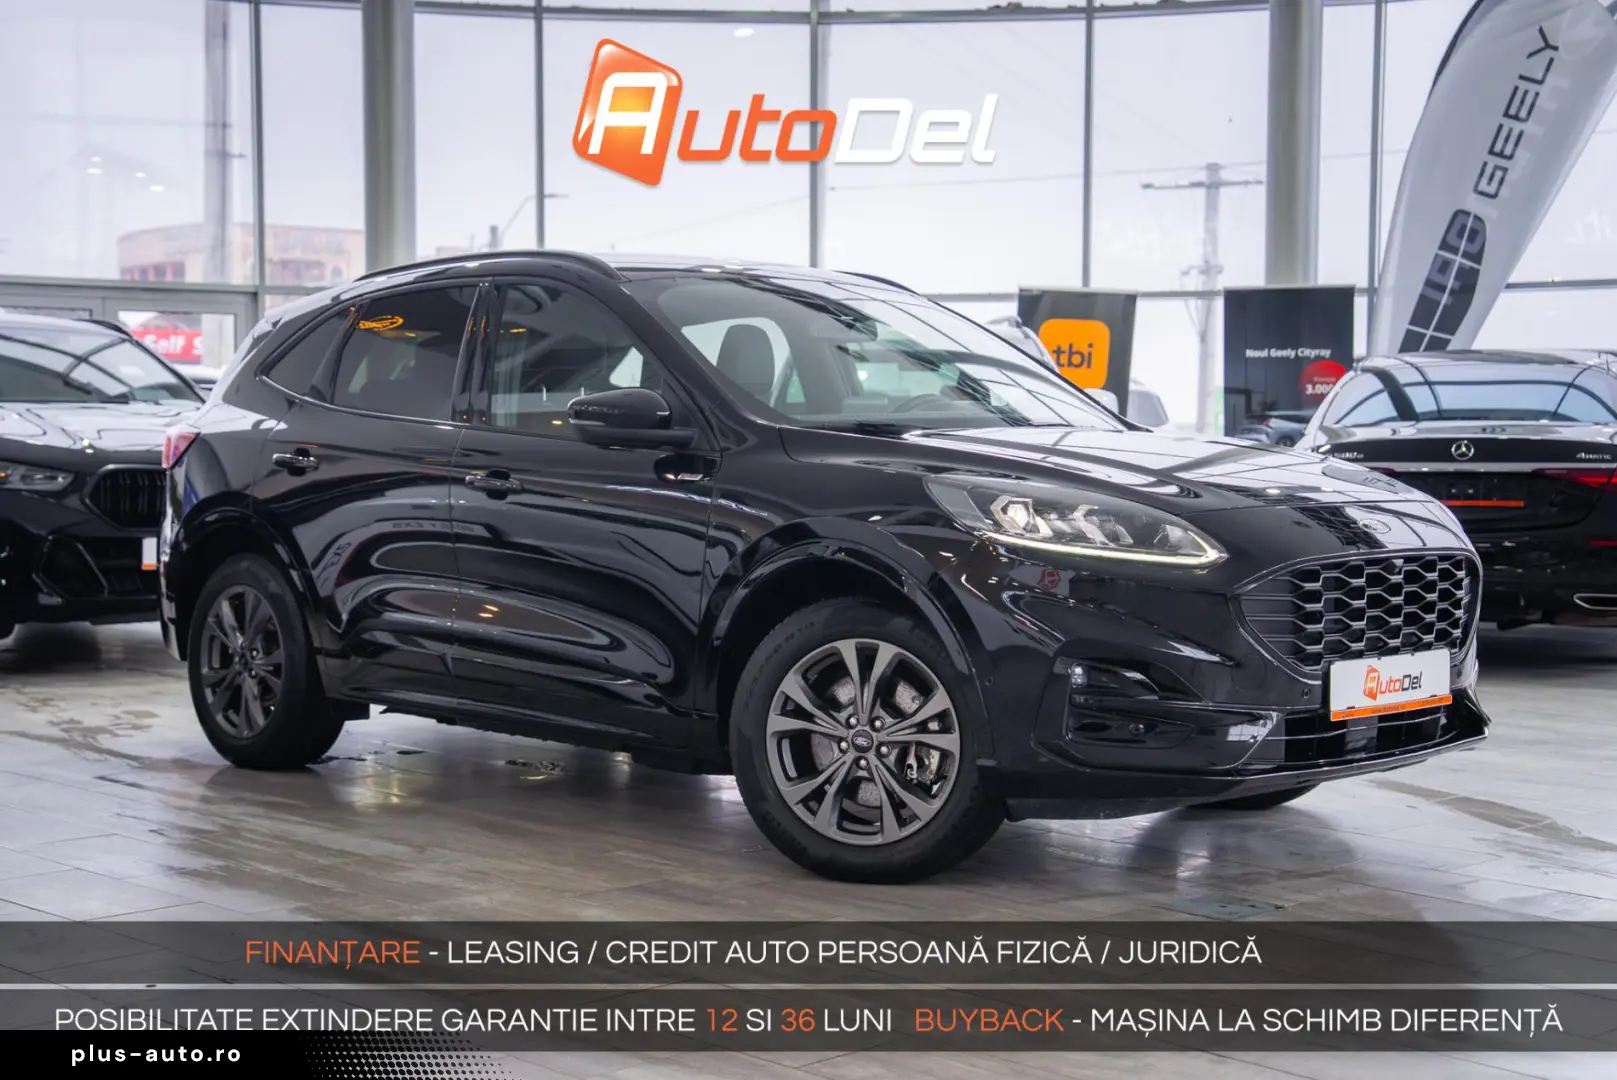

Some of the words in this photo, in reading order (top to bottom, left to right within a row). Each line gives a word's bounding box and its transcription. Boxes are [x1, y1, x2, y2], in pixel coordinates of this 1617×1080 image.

[1473, 25, 1559, 200] GEELY
[1051, 342, 1094, 369] tbi
[1270, 347, 1297, 359] Geely
[1297, 347, 1332, 359] Cityray
[1365, 670, 1422, 695] AutoDel
